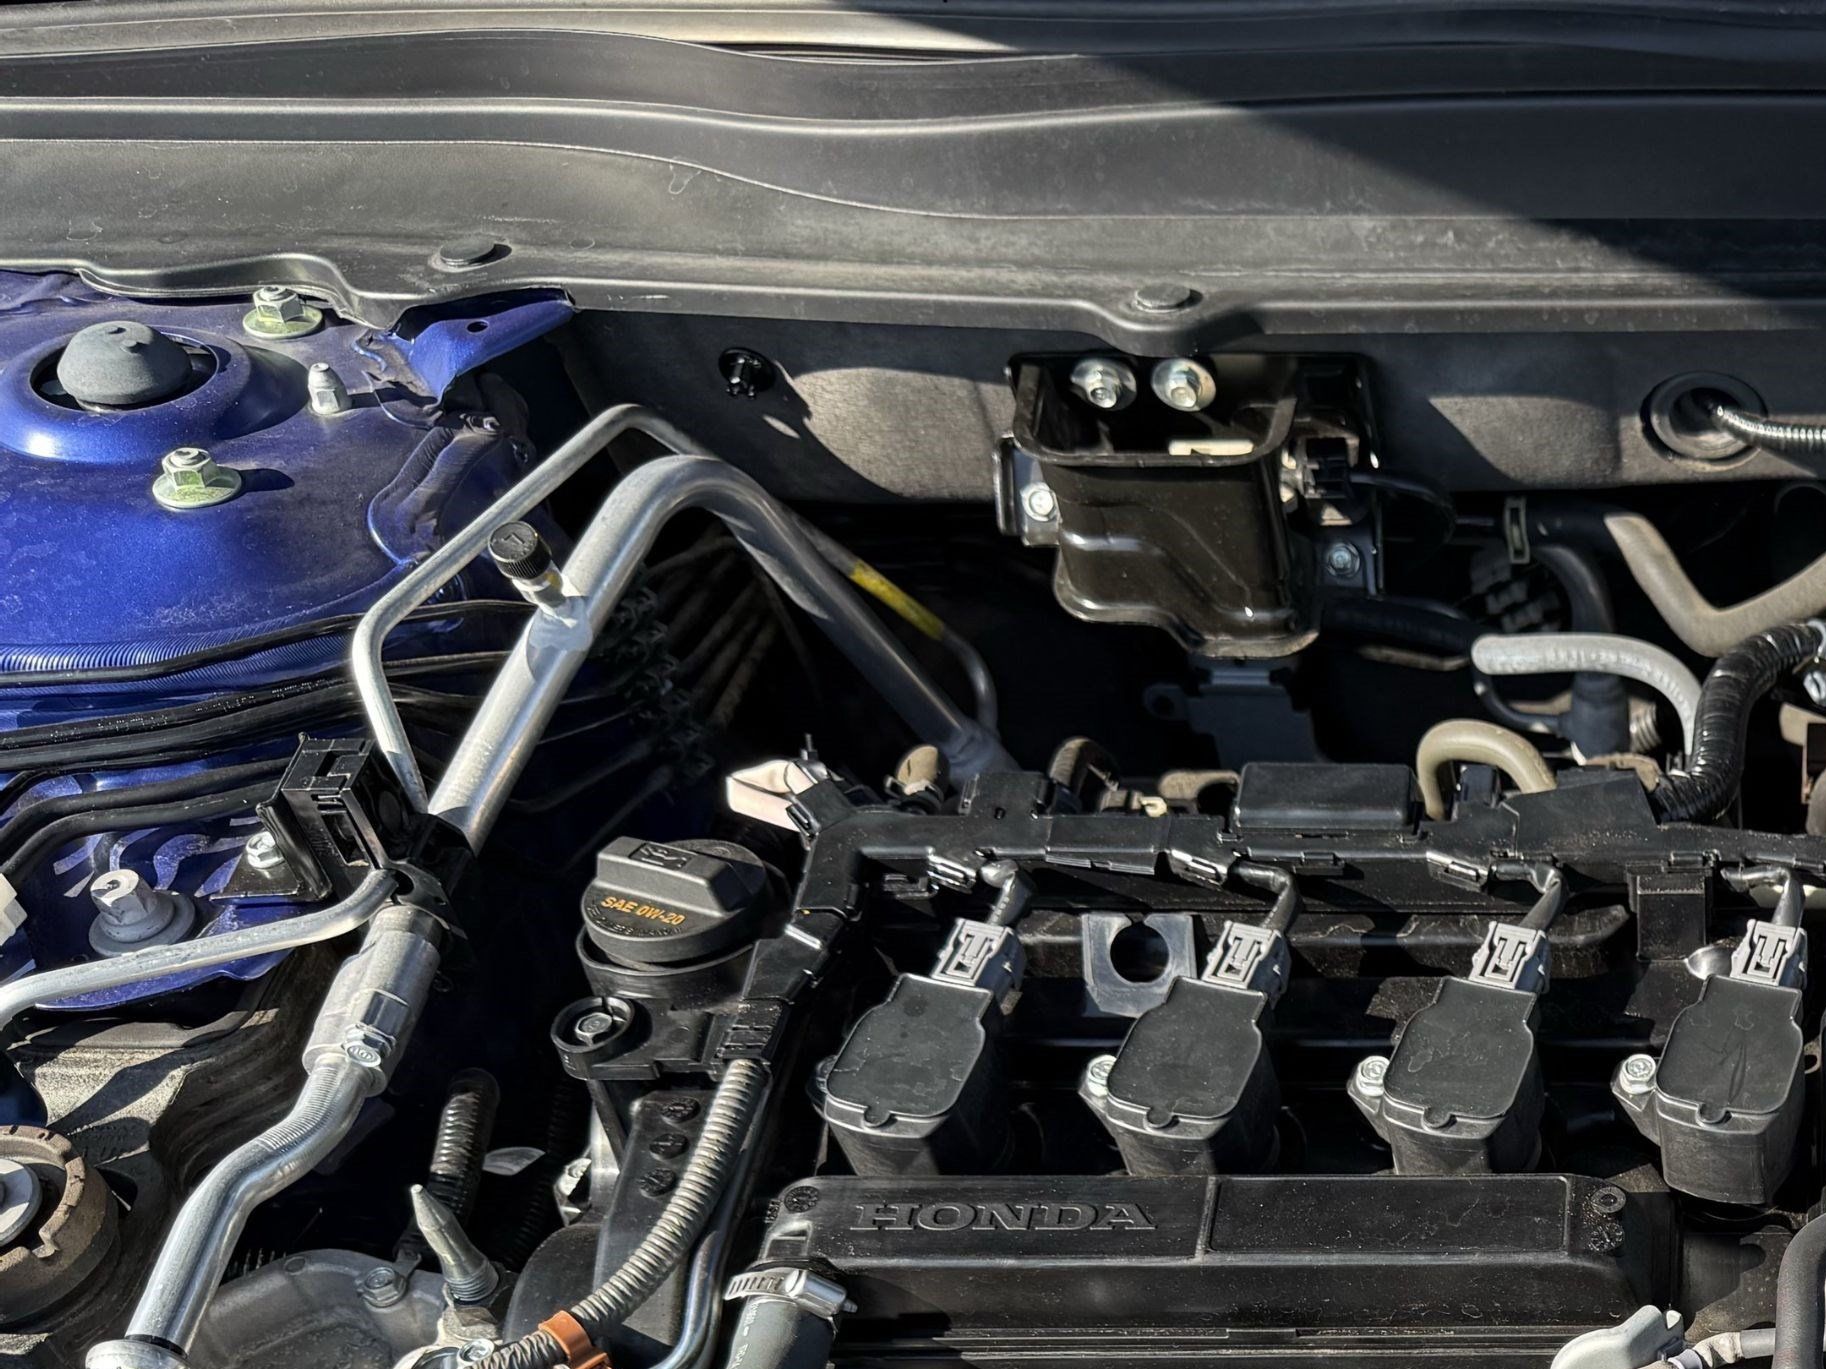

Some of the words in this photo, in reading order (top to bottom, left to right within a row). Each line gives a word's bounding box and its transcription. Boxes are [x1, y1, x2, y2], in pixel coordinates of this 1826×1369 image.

[601, 896, 638, 914] SAE
[636, 904, 686, 926] 0W-20
[850, 1202, 1157, 1231] HONDA
